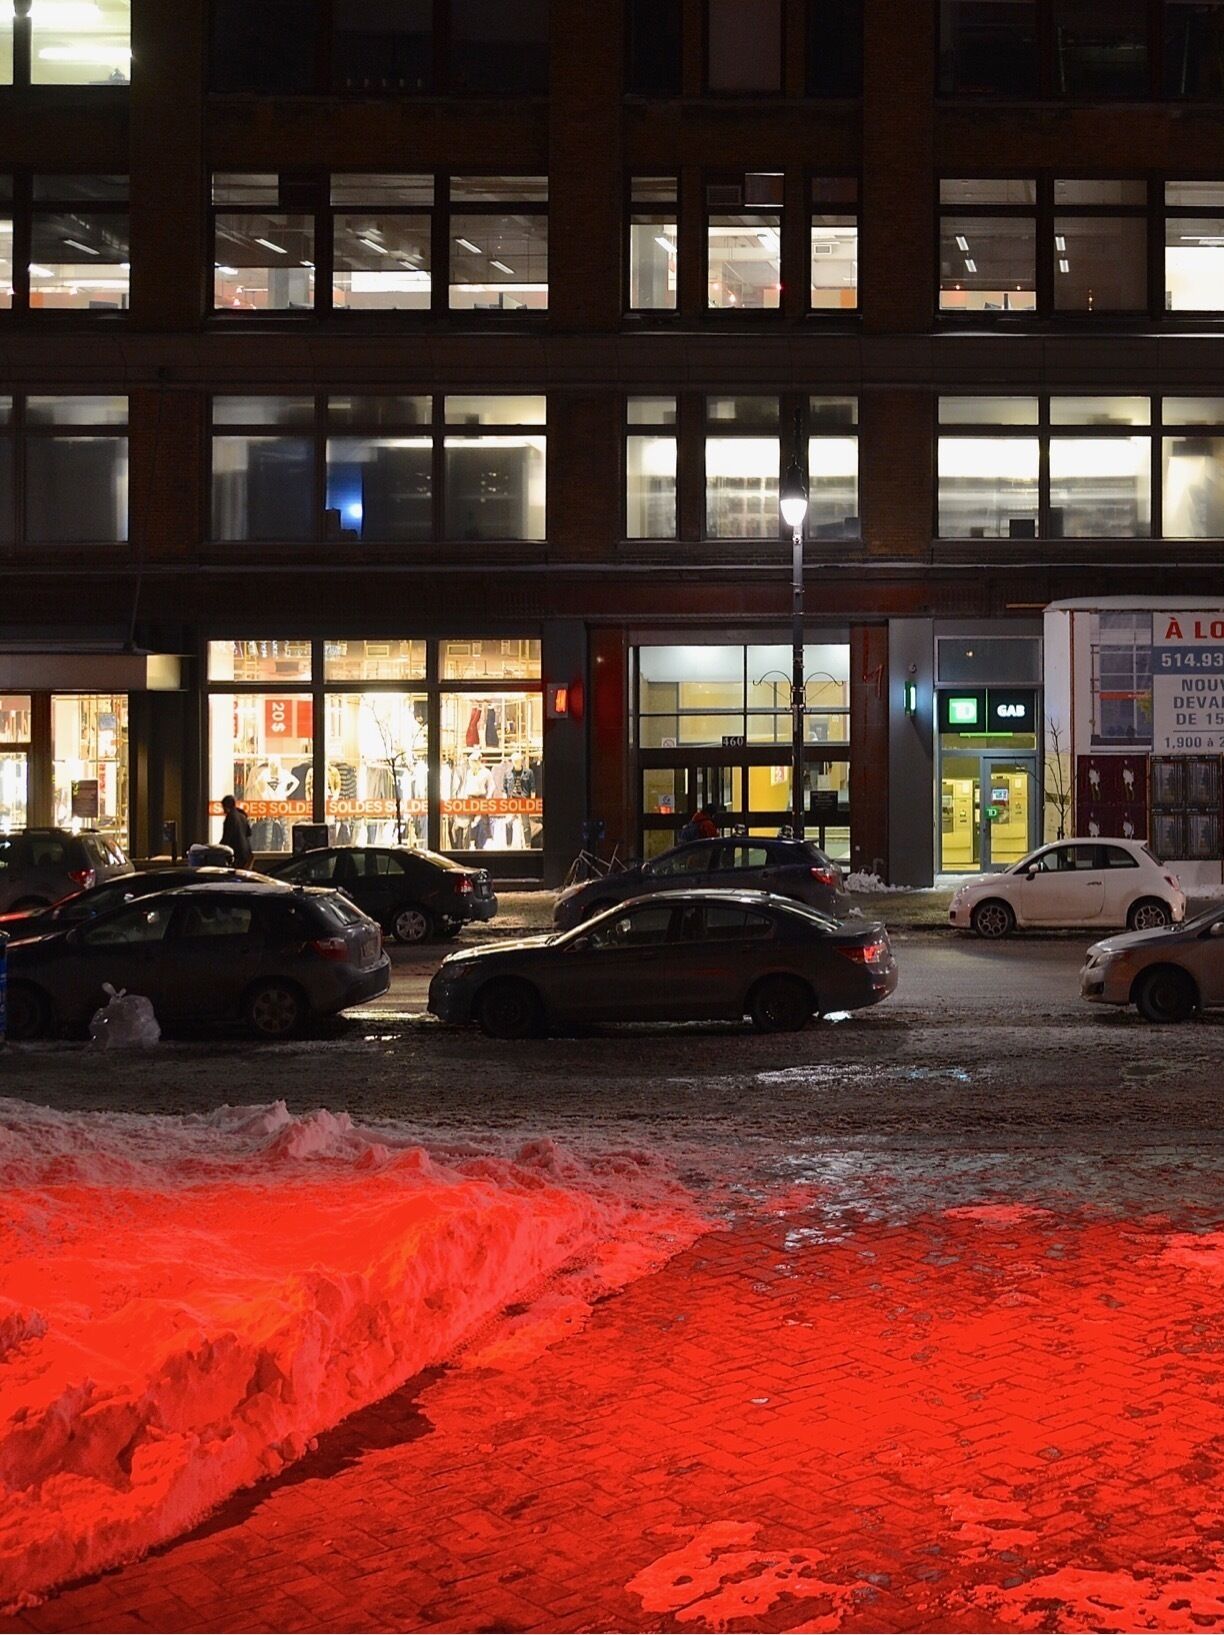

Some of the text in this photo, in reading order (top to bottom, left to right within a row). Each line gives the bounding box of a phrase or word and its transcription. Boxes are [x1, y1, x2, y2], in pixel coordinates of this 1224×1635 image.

[1165, 617, 1183, 639] À
[271, 702, 286, 732] 20$
[997, 704, 1025, 717] GAB
[1176, 713, 1197, 725] DE
[722, 737, 744, 746] 460
[1165, 736, 1202, 749] 1,900
[1207, 737, 1214, 747] à
[213, 801, 266, 814] SDES
[329, 801, 382, 814] SOLDES
[444, 800, 497, 813] SOLDES
